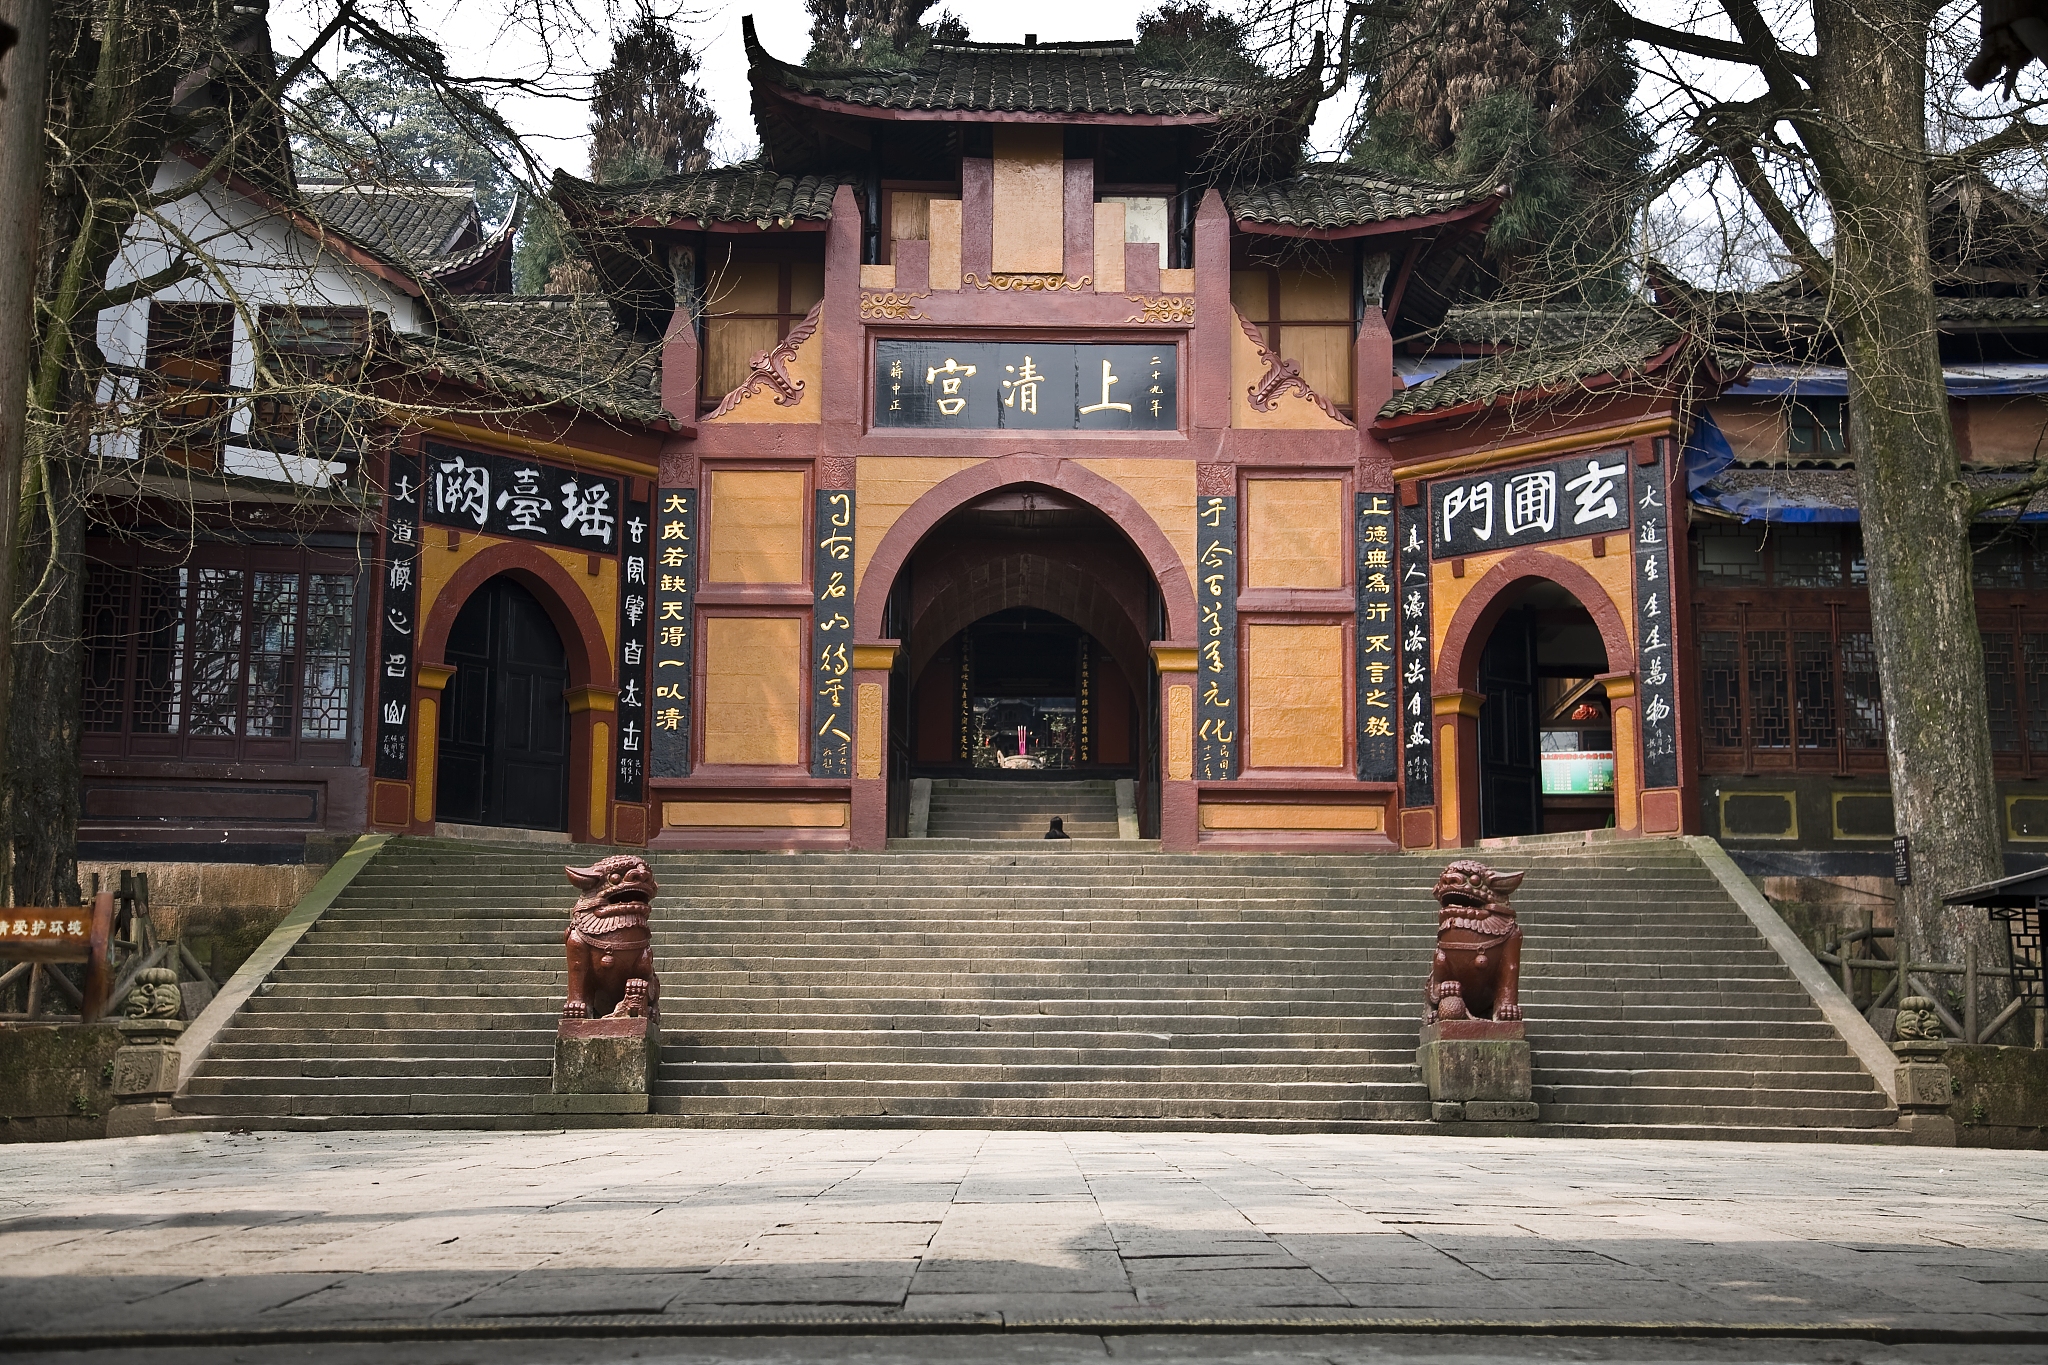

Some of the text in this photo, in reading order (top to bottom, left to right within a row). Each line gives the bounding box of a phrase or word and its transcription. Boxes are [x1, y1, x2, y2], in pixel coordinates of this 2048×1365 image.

[1150, 356, 1163, 417] 二十九年
[656, 494, 689, 731] 大成若缺天得一以清
